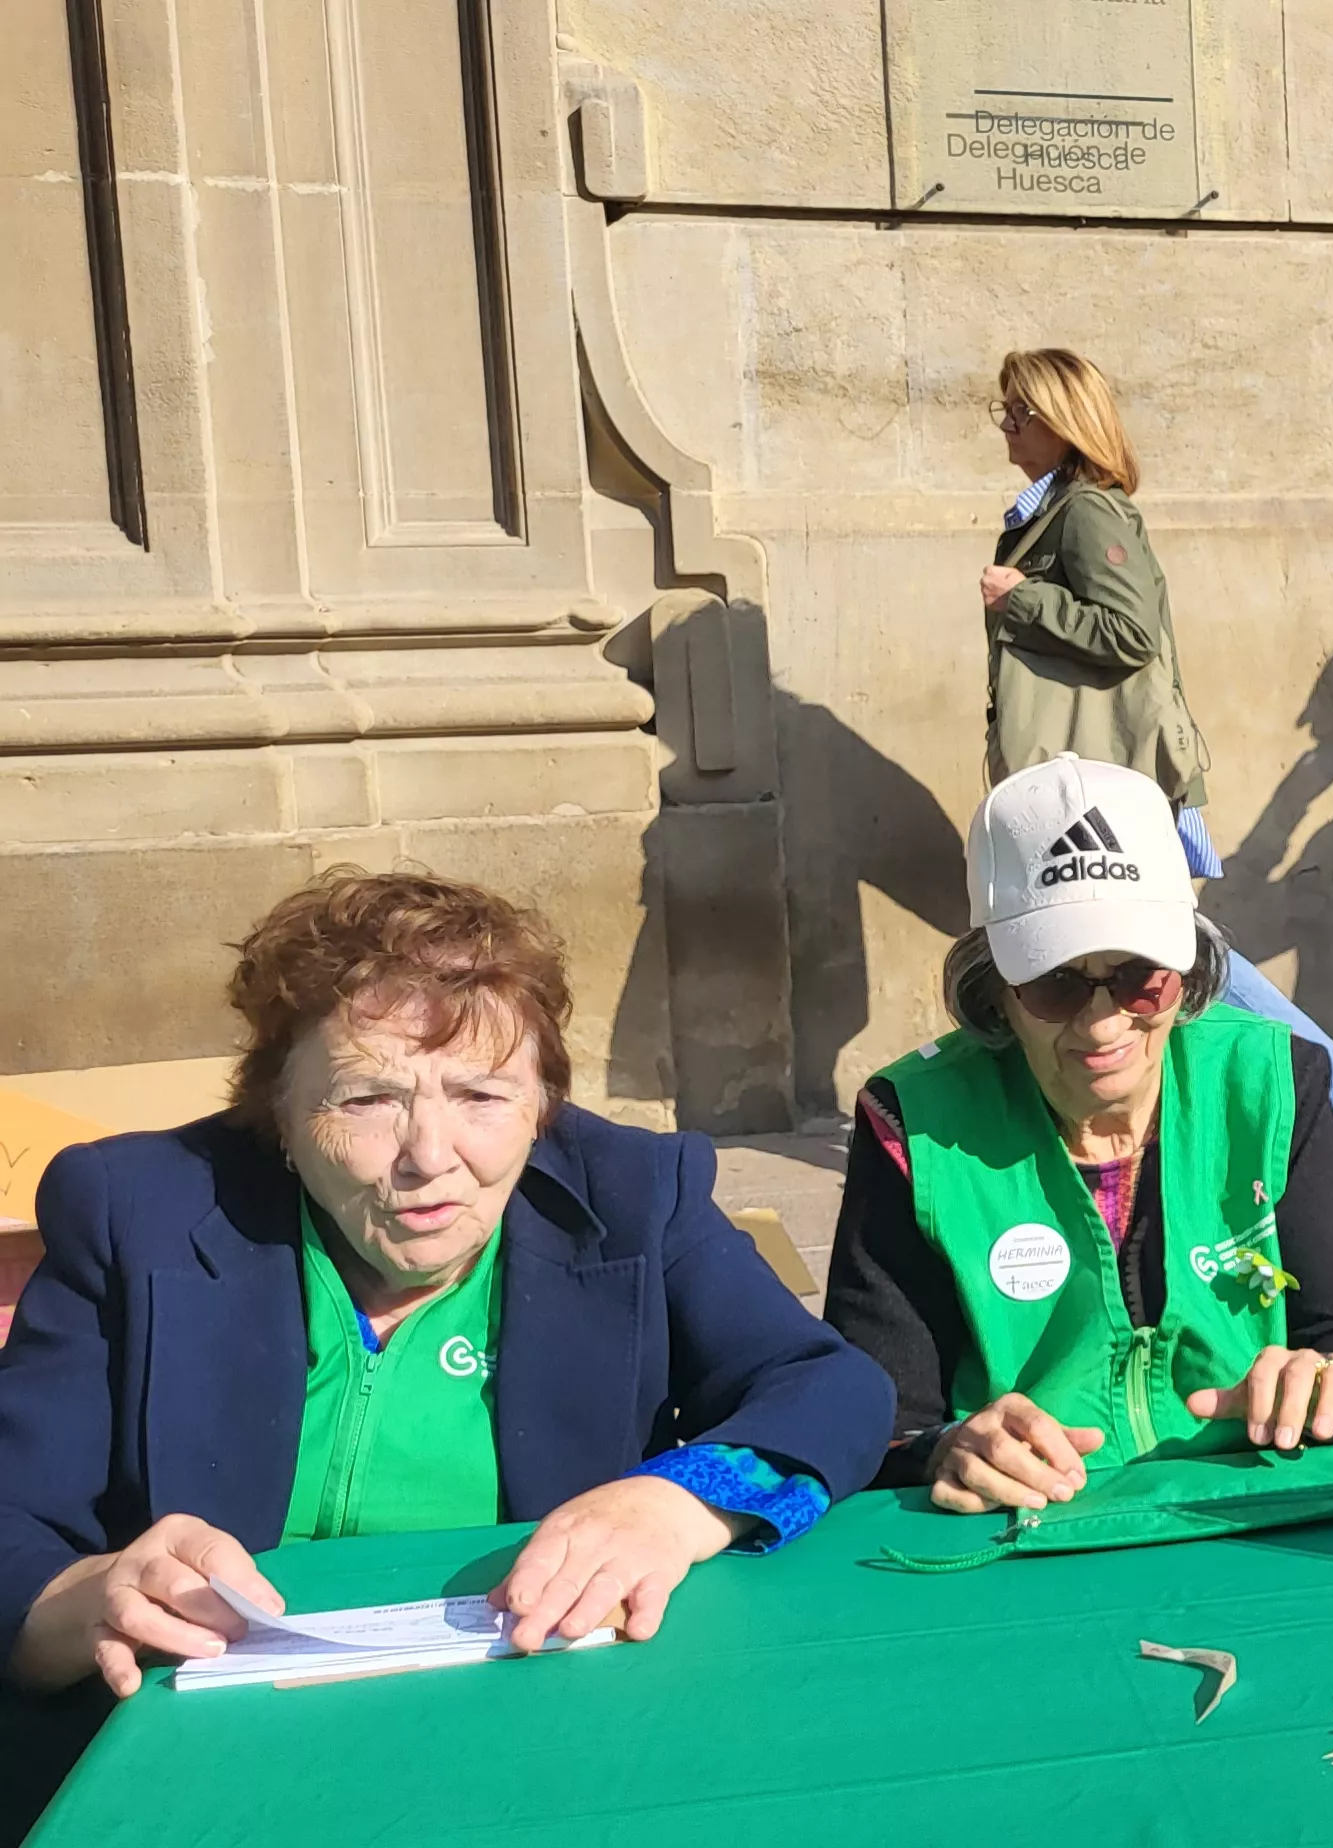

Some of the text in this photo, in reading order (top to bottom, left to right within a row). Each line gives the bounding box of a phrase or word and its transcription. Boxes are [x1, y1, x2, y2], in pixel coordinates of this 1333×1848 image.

[975, 110, 1175, 141] Delegación de
[1025, 143, 1130, 170] Huesca
[996, 167, 1102, 194] Huesca
[1041, 855, 1140, 887] adidas
[997, 1244, 1063, 1261] HERMINIA
